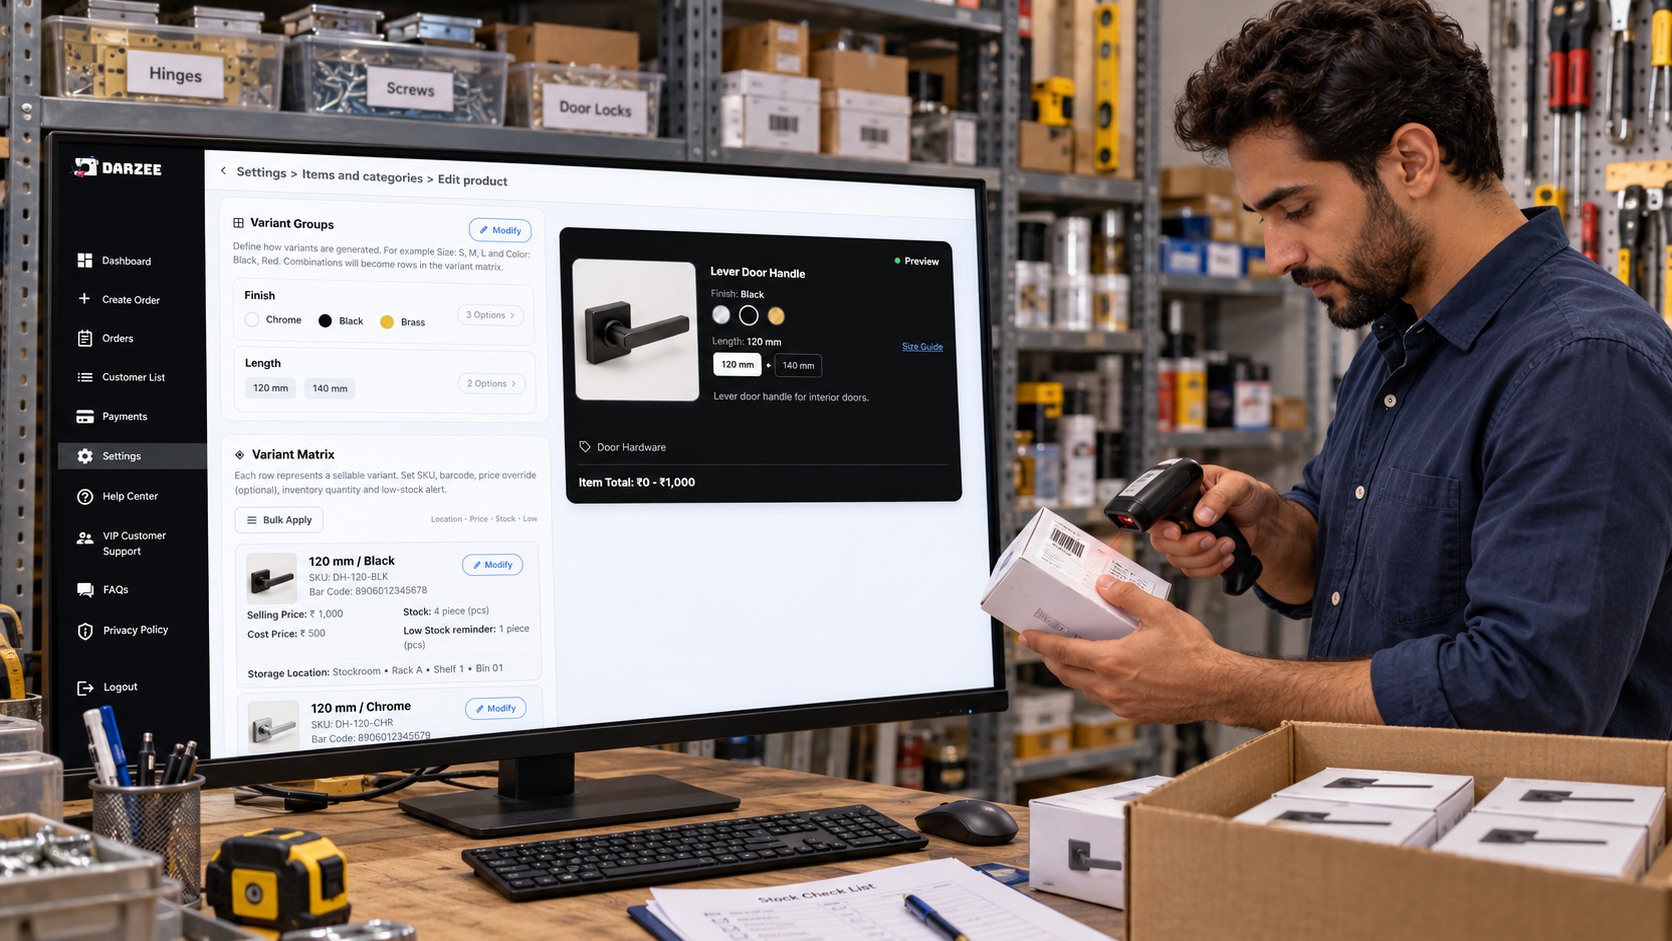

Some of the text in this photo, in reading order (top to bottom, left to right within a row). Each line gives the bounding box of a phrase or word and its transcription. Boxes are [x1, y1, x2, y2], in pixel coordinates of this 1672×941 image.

[150, 66, 202, 85] Hinges
[387, 82, 435, 97] Screws
[560, 100, 632, 118] Door Locks
[103, 162, 161, 176] DARZEE
[237, 167, 508, 187] Settings Items and categories Edit product
[250, 218, 334, 231] Variant Groups
[493, 227, 521, 236] Modify
[233, 242, 261, 251] Define
[264, 243, 282, 251] how
[284, 244, 318, 252] variants
[336, 246, 381, 255] generated.
[384, 246, 397, 254] For
[400, 248, 434, 257] example
[437, 248, 456, 256] Size:
[469, 249, 479, 258] M,
[488, 250, 504, 258] and
[506, 250, 530, 258] Color:
[102, 256, 151, 266] Dashboard
[233, 255, 259, 265] Black,
[262, 256, 281, 265] Red.
[283, 257, 343, 267] Combinations
[345, 259, 359, 267] will
[361, 260, 395, 268] become
[420, 261, 427, 269] in
[445, 262, 473, 270] variant
[475, 263, 503, 271] matrix.
[905, 257, 939, 265] Preview
[711, 267, 805, 278] Lever Door Handle
[245, 291, 275, 300] Finish
[711, 289, 764, 298] Finish: Black
[102, 295, 160, 304] Create Order
[266, 315, 301, 324] Chrome
[340, 317, 363, 325] Black
[402, 318, 425, 326] Brass
[102, 334, 133, 343] Orders
[712, 337, 744, 347] Length:
[747, 337, 763, 346] 120
[246, 358, 281, 369] Length
[102, 373, 165, 381] Customer List
[254, 384, 270, 392] 120
[313, 384, 329, 392] 140
[714, 392, 869, 402] Lever door handle for interior doors.
[103, 412, 147, 422] Payments
[598, 443, 666, 451] Door Hardware
[103, 452, 141, 462] Settings
[252, 449, 334, 459] Variant Matrix
[235, 471, 256, 479] Each
[277, 472, 323, 481] represents
[333, 471, 365, 479] sellable
[367, 471, 398, 479] variant.
[401, 471, 415, 479] Set
[417, 471, 437, 480] SKU,
[440, 471, 476, 480] barcode,
[479, 471, 500, 481] price
[502, 471, 536, 479] override
[579, 477, 695, 489] Item Total: ₹0 ₹1,000
[235, 486, 280, 496] (optional),
[282, 486, 323, 495] inventory
[325, 486, 361, 495] quantity
[382, 485, 423, 493] low-stock
[426, 485, 447, 493] alert.
[103, 492, 158, 502] Help Center
[264, 516, 312, 526] Bulk Apply
[103, 531, 166, 540] VIP Customer
[103, 547, 141, 557] Support
[309, 556, 395, 566] 120 mm Black
[485, 561, 512, 570] Modify
[333, 573, 388, 581] DH-120-BLK
[104, 585, 128, 594] FAQs
[310, 586, 427, 596] Bar Code: 8906012345678
[247, 611, 278, 621] Selling
[281, 610, 307, 618] Price:
[319, 609, 343, 618] 1,000
[403, 607, 431, 616] Stock:
[442, 607, 465, 617] piece
[468, 606, 489, 616] (pcs)
[104, 625, 168, 636] Privacy Policy
[247, 630, 269, 638] Cost
[272, 630, 297, 638] Price:
[308, 628, 326, 637] 500
[404, 627, 422, 635] Low
[425, 626, 450, 634] Stock
[453, 625, 496, 634] reminder:
[507, 624, 529, 634] piece
[404, 641, 425, 651] (pcs)
[248, 670, 284, 680] Storage
[287, 668, 329, 677] Location:
[333, 668, 381, 676] Stockroom
[392, 666, 413, 674] Rack
[434, 665, 456, 673] Shelf
[476, 664, 490, 672] Bin
[492, 664, 503, 672] 01
[104, 683, 137, 693] Logout
[311, 702, 411, 713] 120 mm Chrome
[488, 704, 516, 713] Modify
[312, 718, 393, 729] SKU: DH-120-CHR
[312, 731, 431, 743] Bar Code: 8906012345679
[802, 889, 846, 898] Check
[848, 884, 876, 892] List
